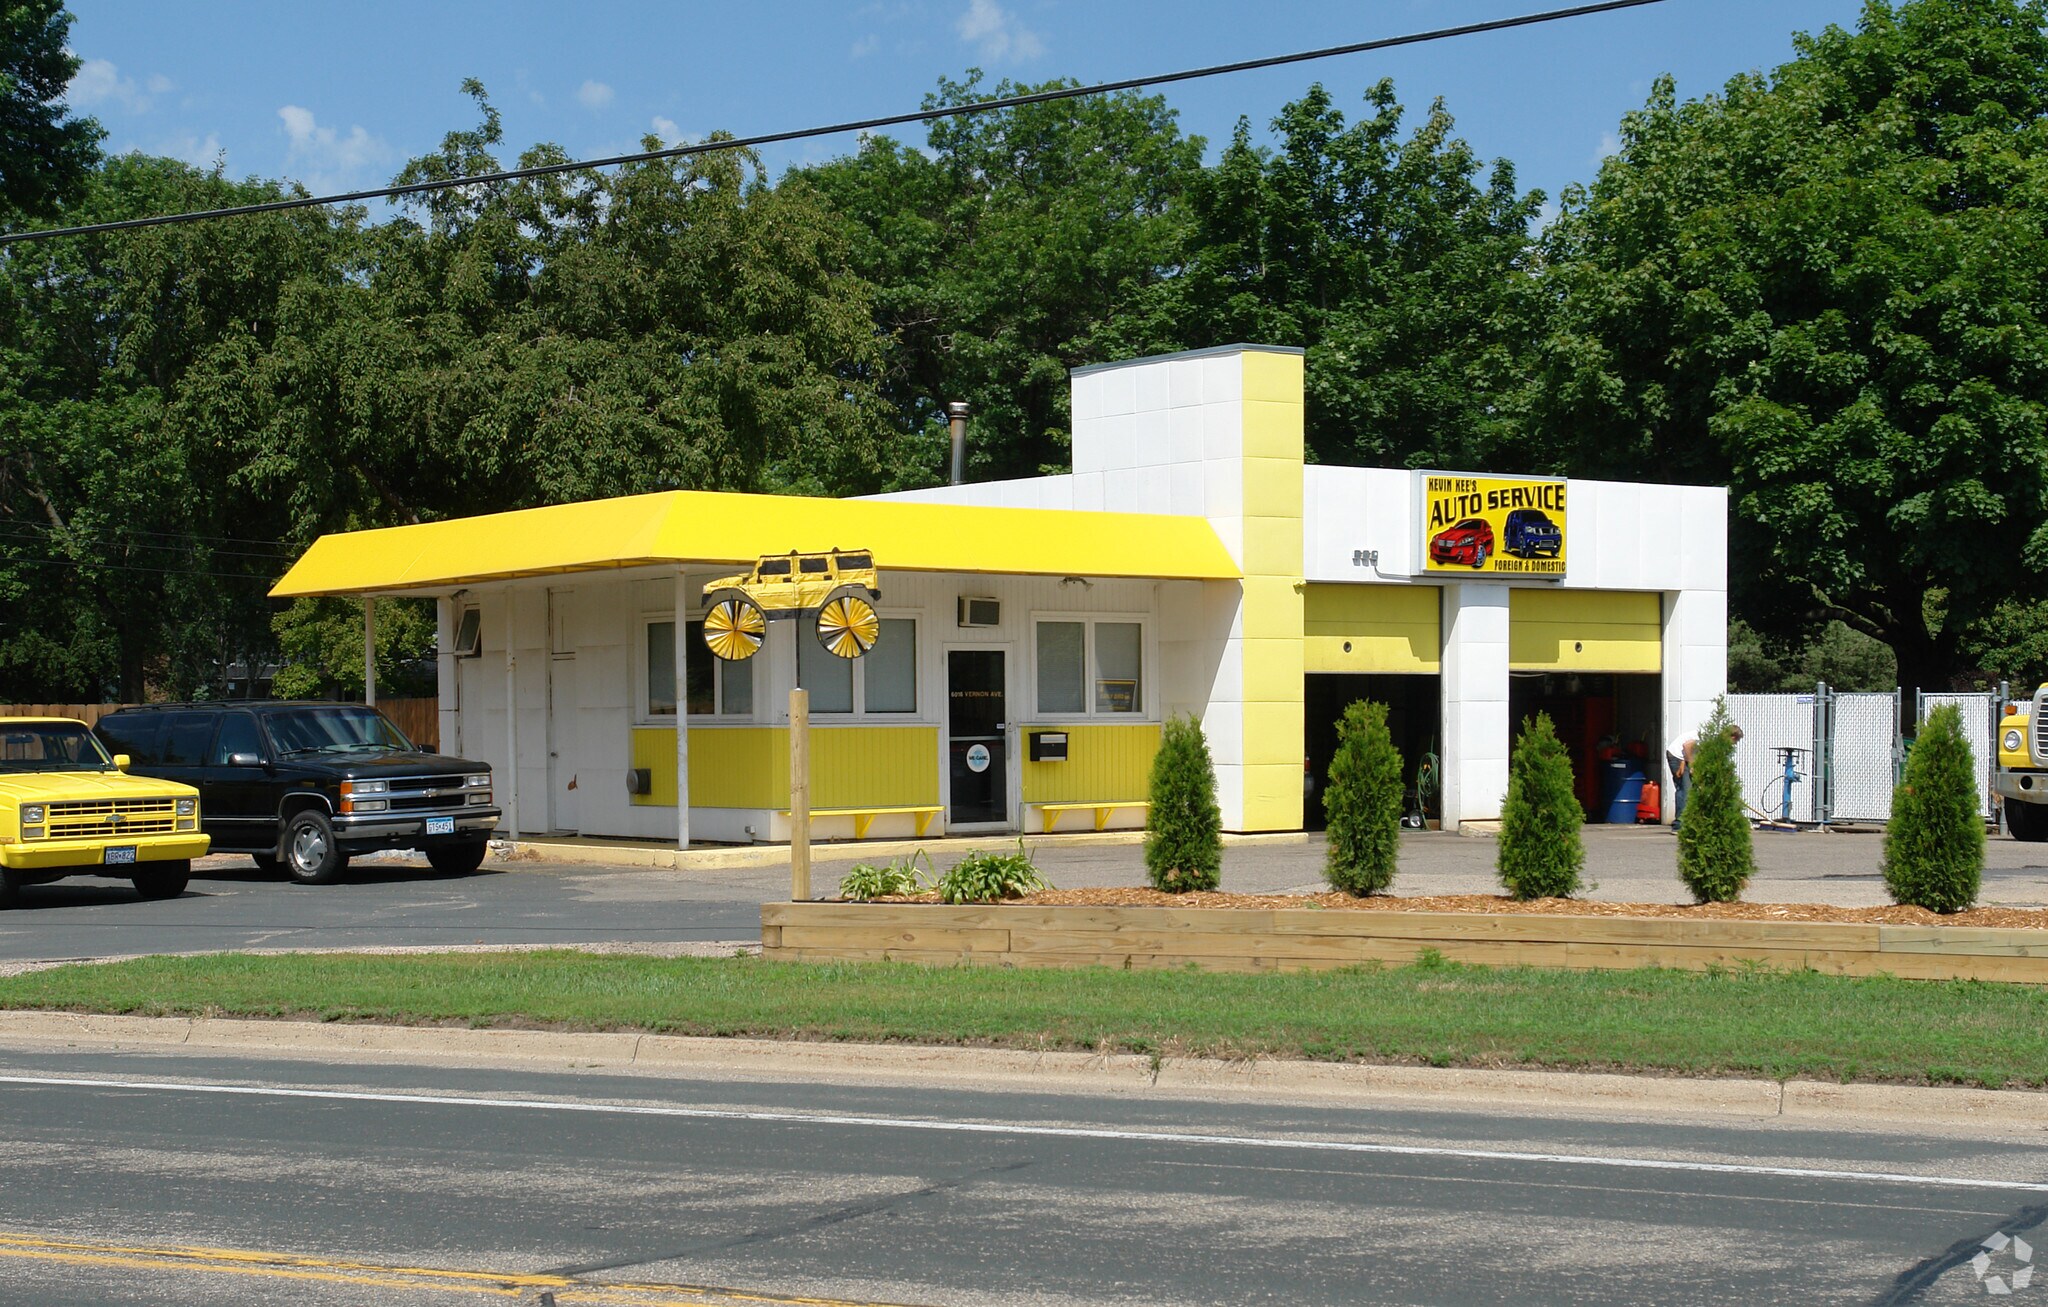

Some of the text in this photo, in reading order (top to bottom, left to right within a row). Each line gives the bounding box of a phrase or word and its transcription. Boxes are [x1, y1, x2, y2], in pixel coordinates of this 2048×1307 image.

[1428, 478, 1477, 493] KEVIN KEE'S
[1429, 484, 1565, 530] AUTO SERVICE
[1494, 559, 1566, 572] FOREIGN & DOMESTIC
